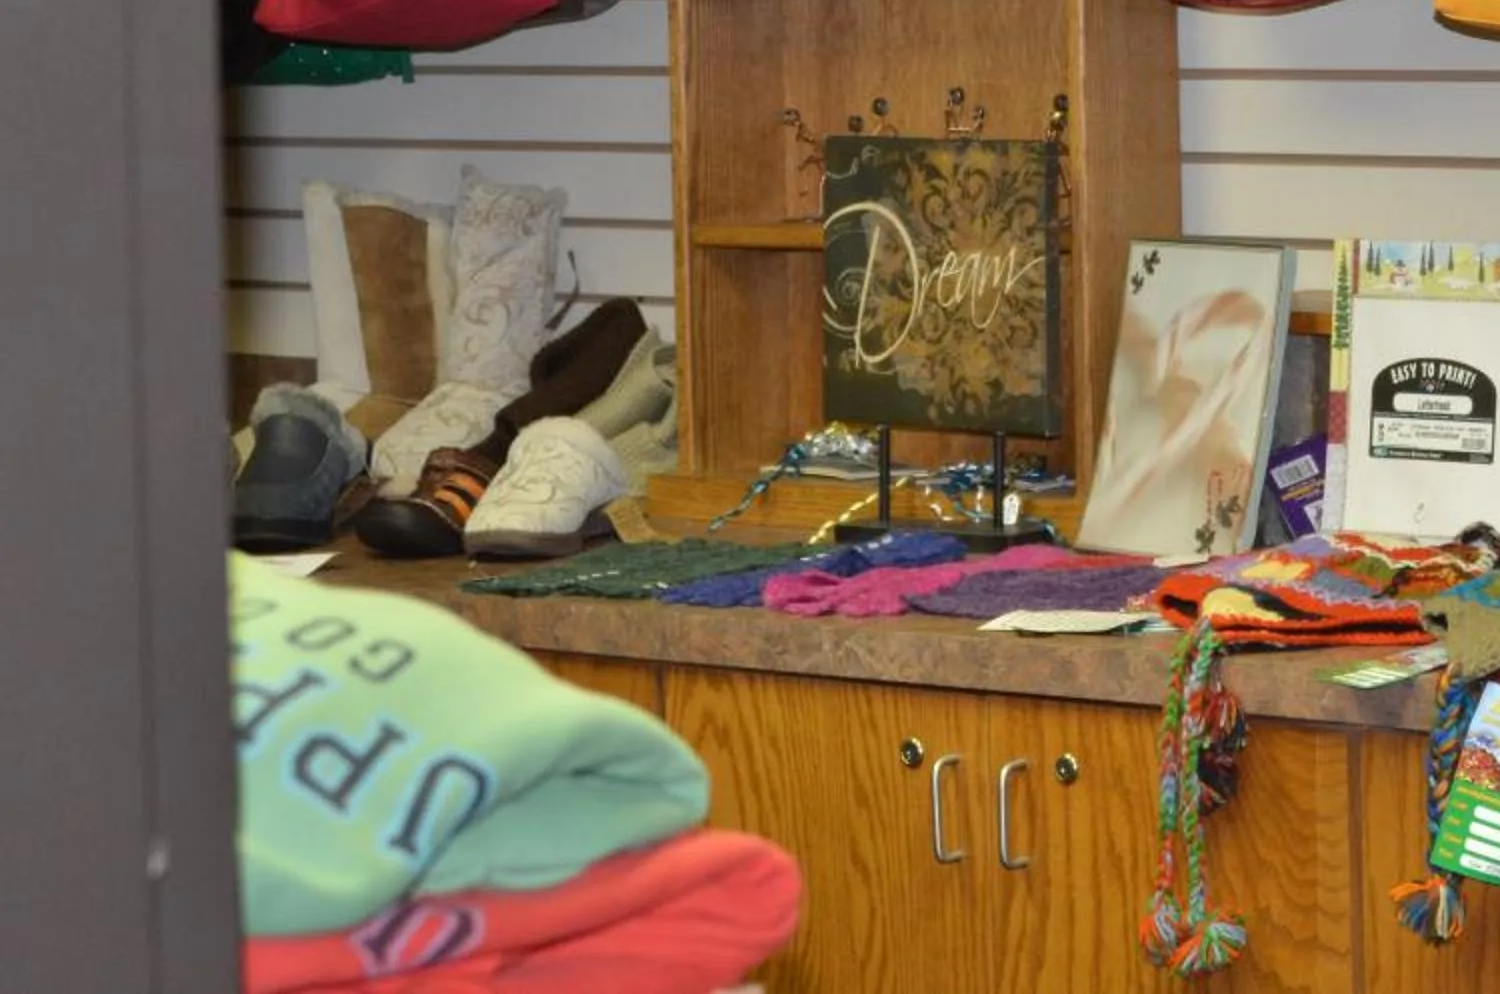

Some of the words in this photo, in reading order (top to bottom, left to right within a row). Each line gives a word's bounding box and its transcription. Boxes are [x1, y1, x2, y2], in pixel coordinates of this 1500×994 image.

[1390, 362, 1418, 385] EASY
[1421, 362, 1435, 379] TO
[1439, 363, 1478, 390] PRINT!
